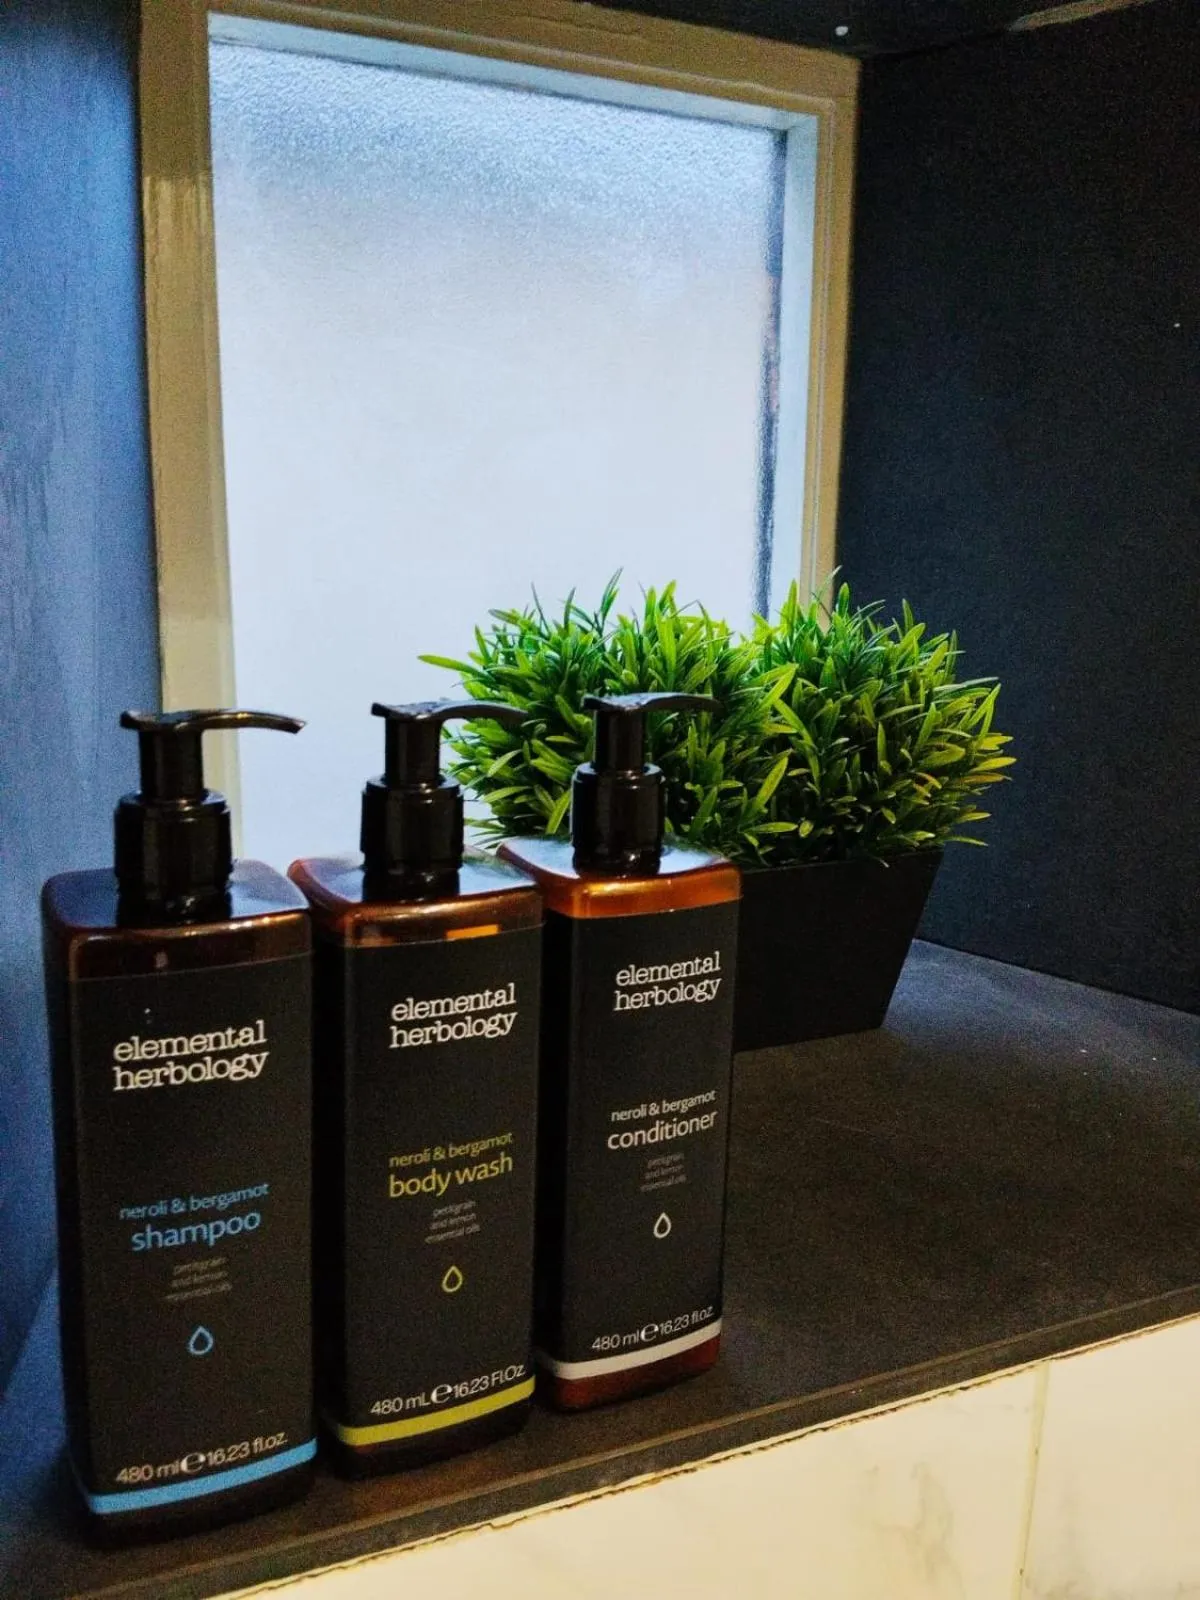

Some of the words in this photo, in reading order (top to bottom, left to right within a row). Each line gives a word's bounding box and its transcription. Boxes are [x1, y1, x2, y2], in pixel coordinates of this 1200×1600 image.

[616, 950, 721, 986] elemental
[391, 982, 517, 1021] elemental
[613, 978, 722, 1011] herbology
[113, 1019, 267, 1061] elemental
[389, 1011, 518, 1048] herbology
[112, 1051, 269, 1091] herbology
[611, 1103, 648, 1121] neroli
[648, 1102, 660, 1116] &
[662, 1090, 717, 1113] bergamot
[607, 1111, 718, 1150] conditioner
[389, 1147, 431, 1168] neroli
[433, 1145, 447, 1161] &
[448, 1132, 513, 1158] bergamot
[389, 1167, 452, 1199] body
[455, 1151, 513, 1185] wash
[119, 1199, 168, 1221] neroli
[170, 1197, 187, 1214] &
[190, 1183, 269, 1211] bergamot
[131, 1210, 262, 1251] shampoo
[591, 1333, 620, 1351] 480
[370, 1397, 403, 1416] 480
[115, 1463, 154, 1485] 480
